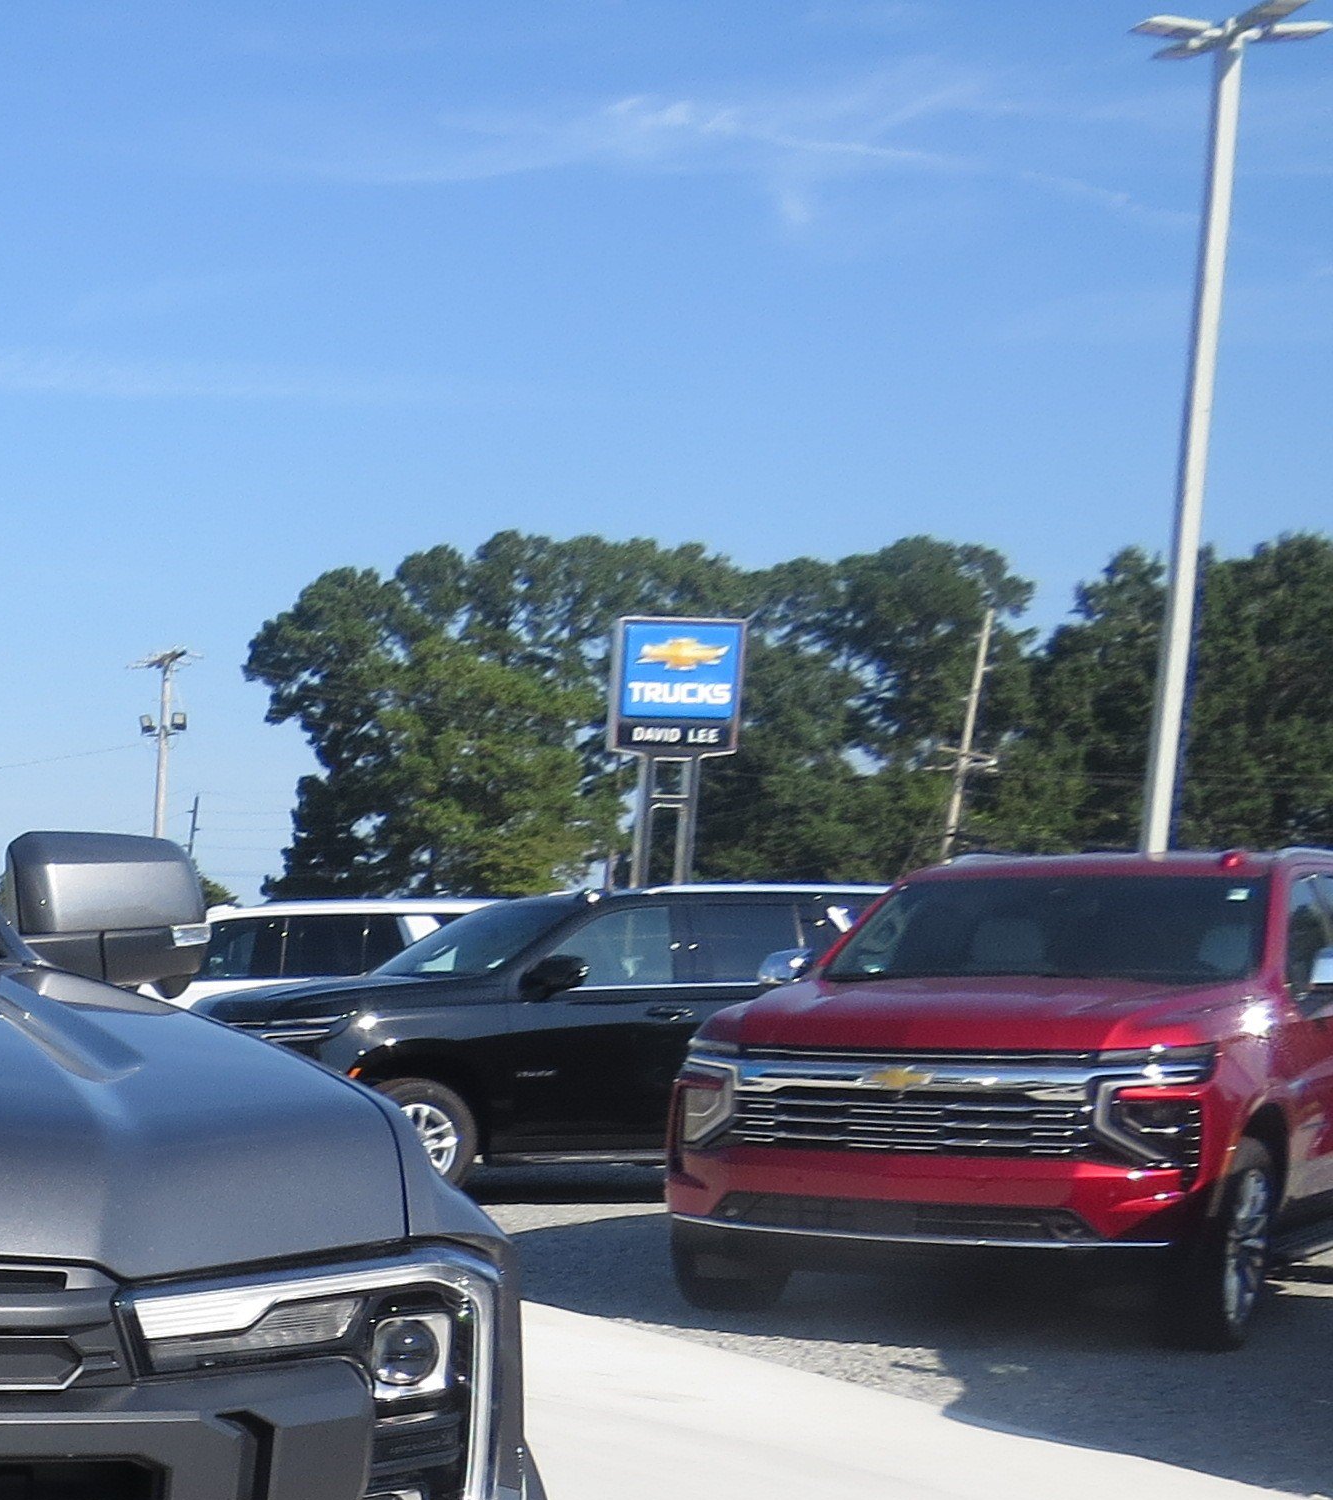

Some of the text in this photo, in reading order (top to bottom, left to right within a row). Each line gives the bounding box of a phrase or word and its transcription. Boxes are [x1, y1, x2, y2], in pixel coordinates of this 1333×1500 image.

[628, 681, 732, 705] TRUCKS
[632, 726, 720, 743] DAVID LEE
